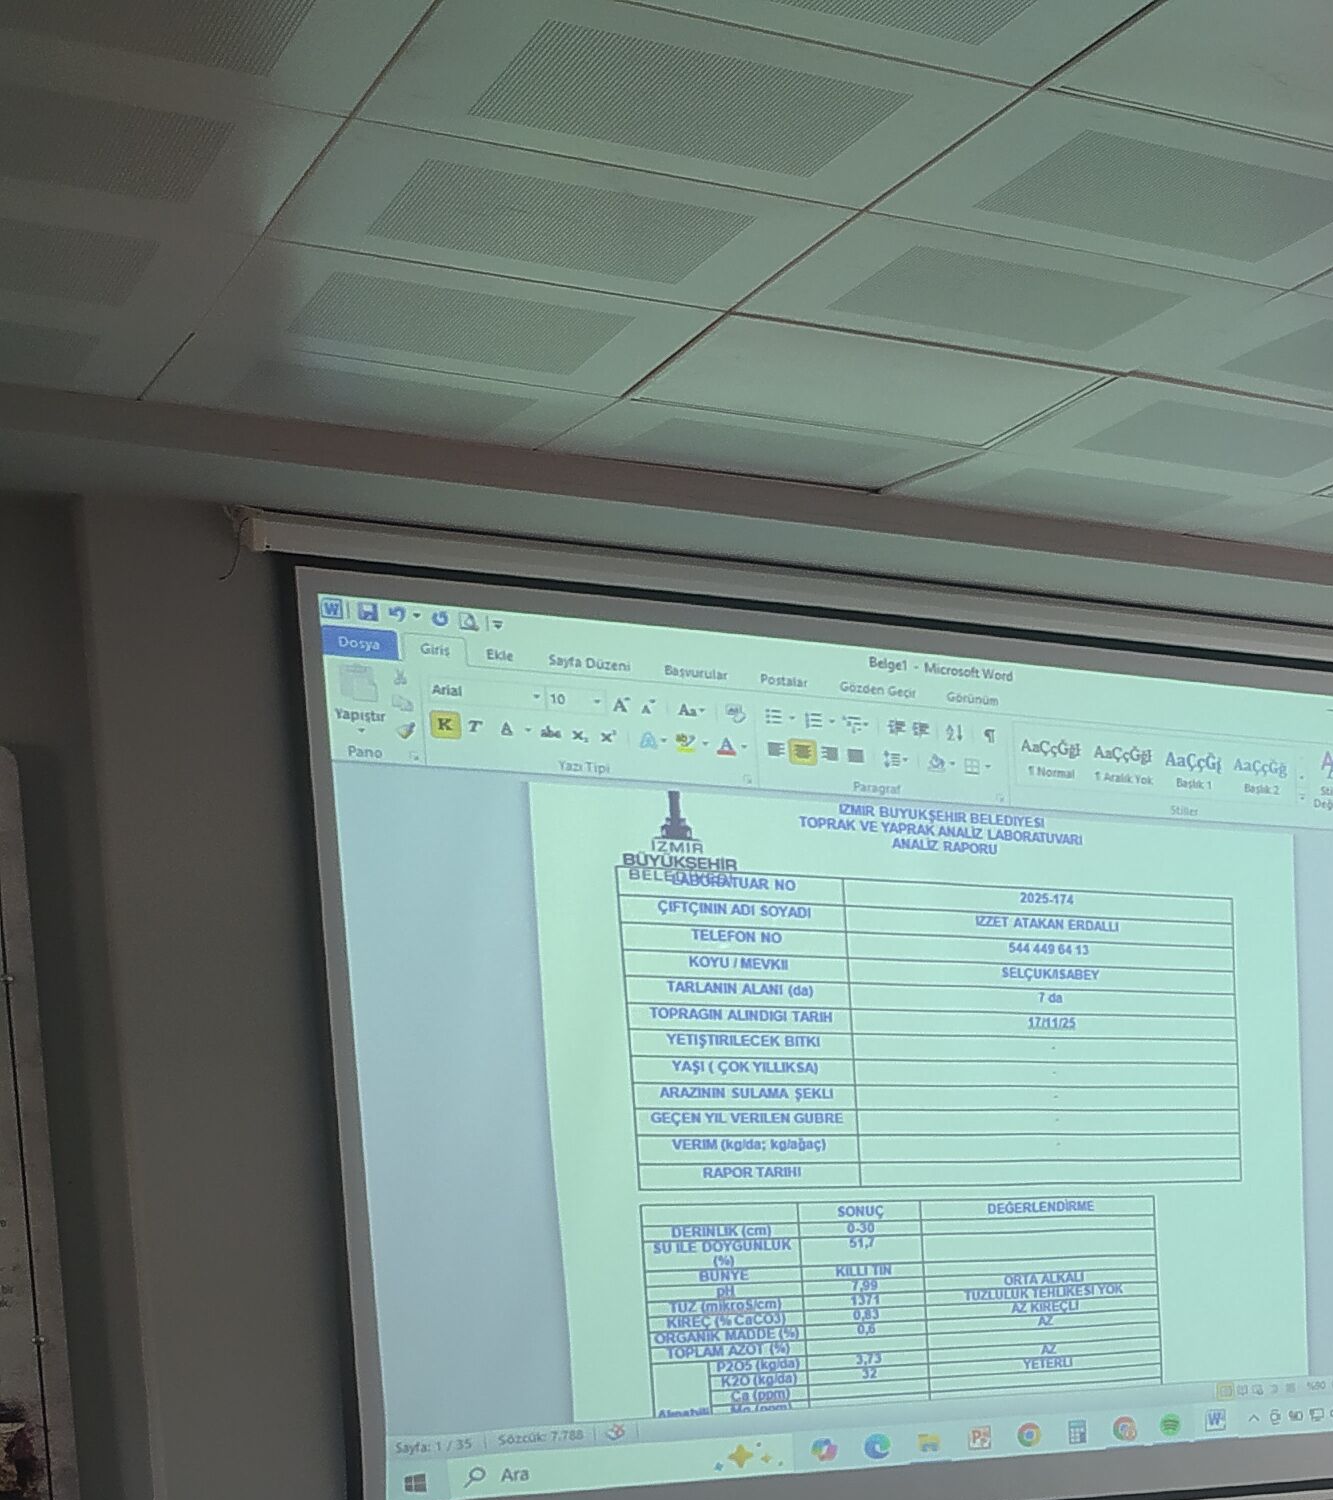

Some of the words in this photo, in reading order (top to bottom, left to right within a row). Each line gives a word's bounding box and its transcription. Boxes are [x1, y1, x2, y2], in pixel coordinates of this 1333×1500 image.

[338, 636, 380, 651] Dosya
[420, 643, 451, 656] Giriş
[486, 648, 514, 662] Ekle
[548, 654, 582, 671] Sayfa
[585, 657, 631, 673] Düzeni
[664, 665, 728, 681] Başvurular
[924, 662, 980, 679] Microsoft
[983, 668, 1014, 682] Word
[760, 674, 808, 688] Postalar
[432, 684, 462, 697] Arial
[550, 693, 566, 705] 10
[347, 745, 383, 759] Pano
[853, 781, 902, 796] Paragraf
[799, 816, 855, 831] TOPRAK
[860, 820, 878, 832] VE
[881, 822, 934, 836] YAPRAK
[987, 829, 1083, 845] LABORATUVARI
[943, 841, 998, 855] RAPORU
[775, 879, 796, 891] NO
[1020, 891, 1074, 905] 2025-174
[731, 904, 755, 917] ADI
[760, 905, 812, 919] SOYADI
[1013, 917, 1065, 930] ATAKAN
[692, 929, 756, 943] TELEFON
[761, 932, 782, 944] NO
[1008, 942, 1030, 954] 544
[1033, 943, 1055, 955] 449
[1058, 943, 1073, 955] 64
[1075, 944, 1089, 955] 13
[667, 980, 738, 995] TARLANIN
[742, 983, 784, 996] ALANI
[788, 984, 814, 998] (da)
[1039, 992, 1045, 1003] 7
[1048, 992, 1063, 1003] da
[672, 1060, 704, 1075] YAŞI
[717, 1060, 750, 1076] ÇOK
[752, 1061, 819, 1075] YILLIKSA)
[731, 1088, 789, 1100] SULAMA
[650, 1112, 702, 1127] GEÇEN
[705, 1112, 727, 1124] YIL
[703, 1167, 753, 1179] RAPOR
[837, 1205, 884, 1220] SONUÇ
[988, 1199, 1094, 1216] DEĞERLENDİRME
[742, 1224, 771, 1238] (cm)
[846, 1222, 875, 1234] 0-30
[653, 1242, 672, 1254] SU
[713, 1254, 734, 1267] (%)
[851, 1280, 878, 1293] 7,99
[1004, 1274, 1038, 1286] ORTA
[716, 1285, 735, 1299] pH
[964, 1288, 1029, 1301] TUZLULUK
[1098, 1284, 1124, 1296] YOK
[668, 1301, 697, 1313] TUZ
[1012, 1302, 1028, 1313] AZ
[734, 1313, 787, 1327] CaCO3)
[853, 1309, 879, 1321] 0,83
[1038, 1315, 1054, 1326] AZ
[724, 1329, 776, 1341] MADDE
[779, 1327, 800, 1341] (%)
[667, 1346, 724, 1359] TOPLAM
[728, 1344, 763, 1356] AZOT
[769, 1342, 790, 1355] (%)
[1041, 1344, 1057, 1355] AZ
[756, 1358, 800, 1372] (kg/da)
[856, 1353, 882, 1366] 3,73
[753, 1373, 798, 1388] (kg/da)
[862, 1369, 877, 1380] 32
[730, 1389, 749, 1401] Ca
[753, 1387, 790, 1402] (ppm)
[457, 1440, 472, 1449] 35
[501, 1467, 529, 1482] Ara
